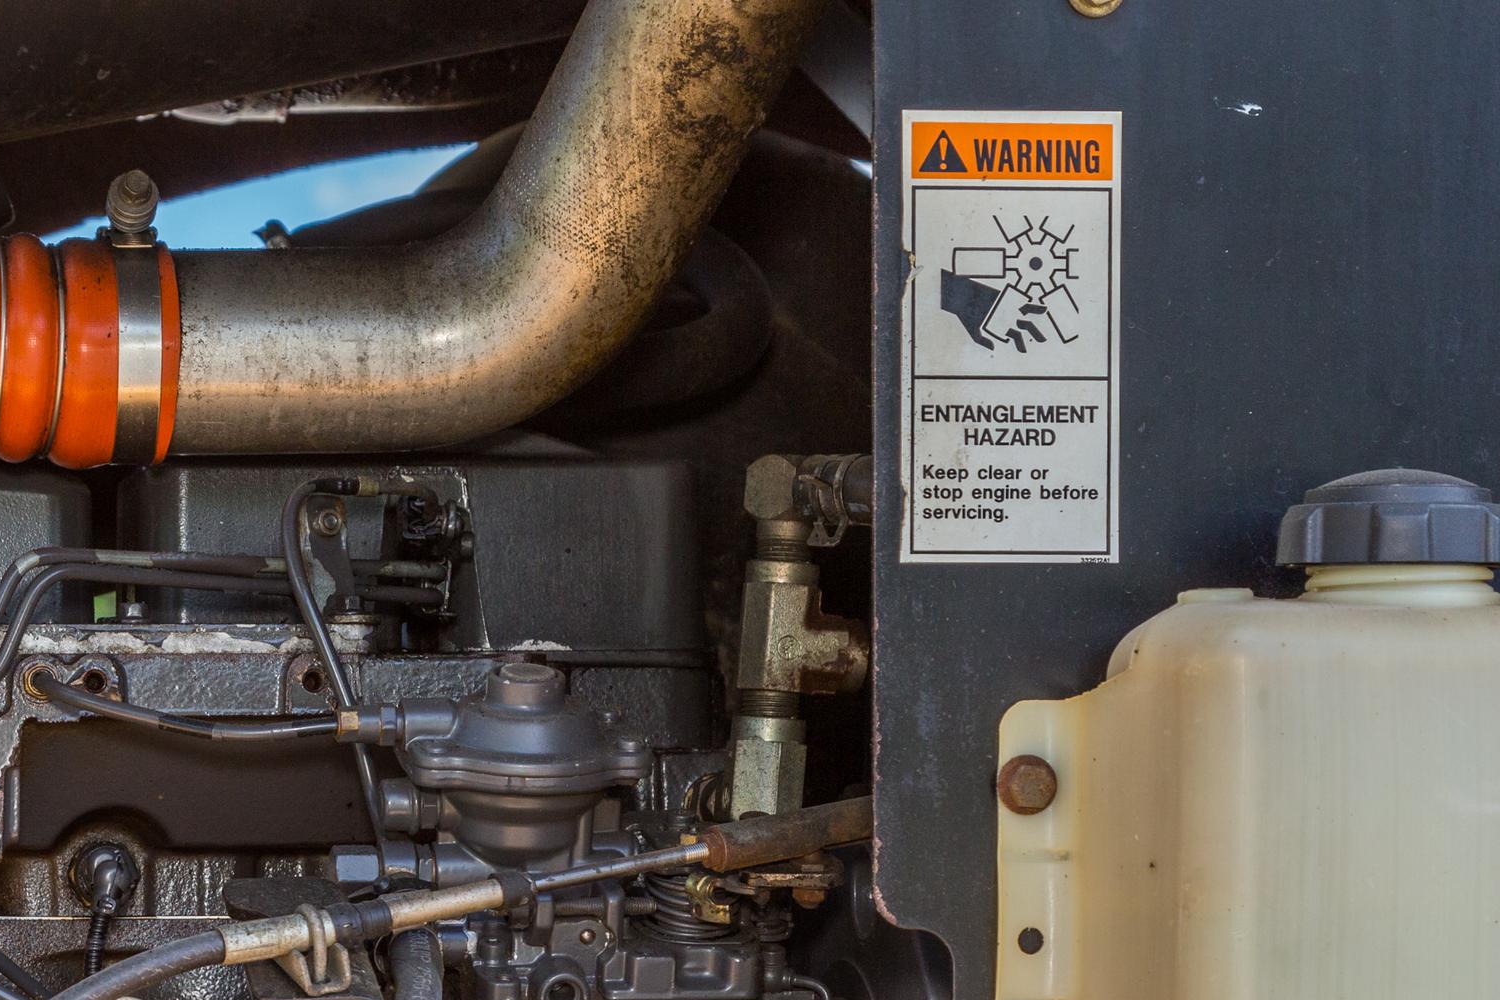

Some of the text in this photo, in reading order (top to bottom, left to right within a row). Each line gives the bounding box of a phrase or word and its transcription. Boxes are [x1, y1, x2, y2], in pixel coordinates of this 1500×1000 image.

[973, 138, 1100, 174] WARNING
[920, 404, 1099, 424] ENTANGLEMENT
[963, 428, 1056, 446] HAZARD
[922, 464, 1050, 482] Keep clear or
[922, 484, 1099, 502] stop engine before
[922, 504, 1009, 523] servicing.
